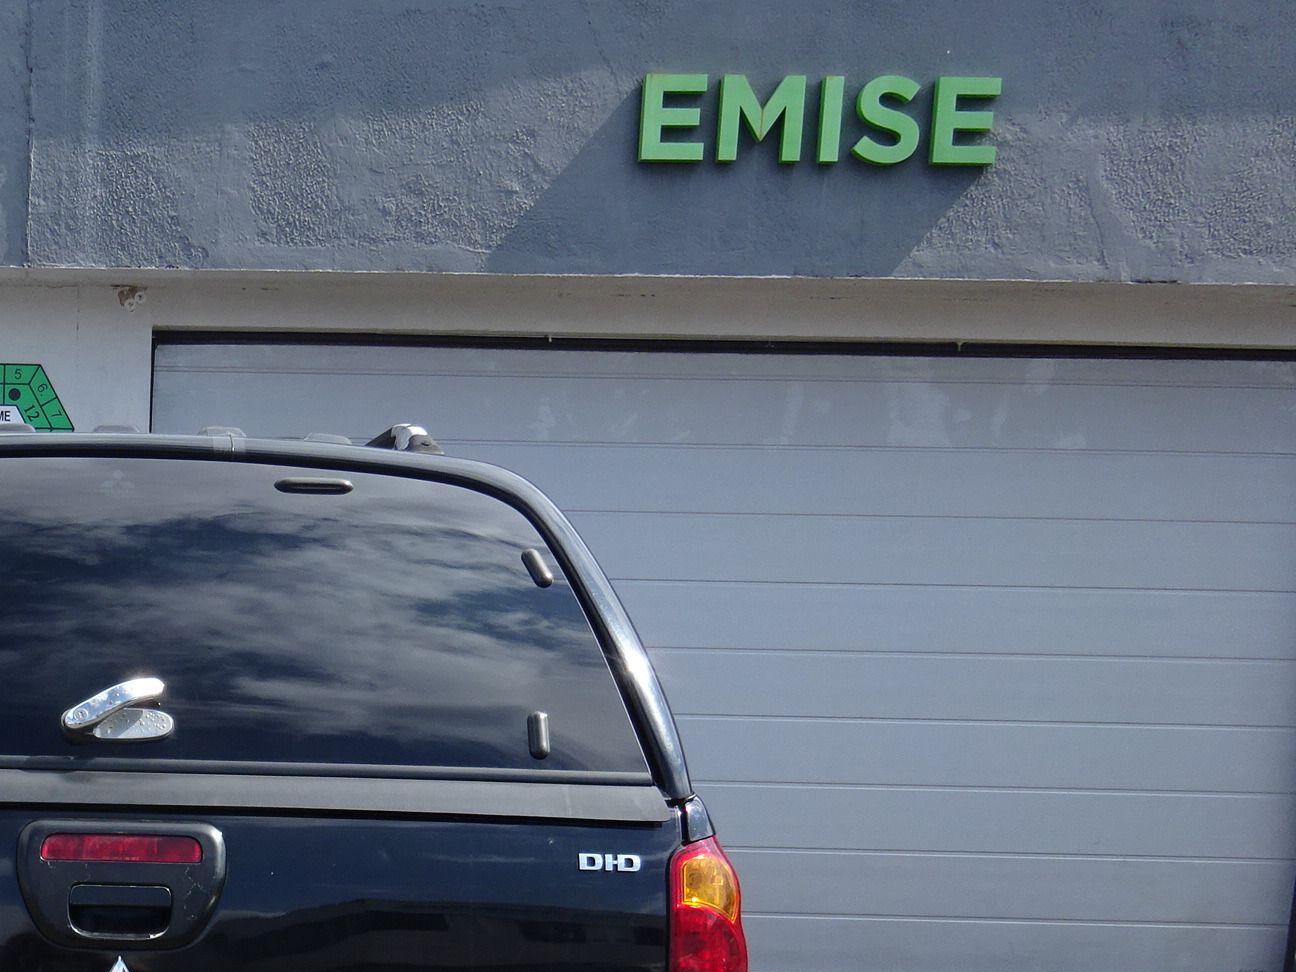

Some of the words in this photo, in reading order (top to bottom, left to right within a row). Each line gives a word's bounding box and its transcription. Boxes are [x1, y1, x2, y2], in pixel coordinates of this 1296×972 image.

[638, 73, 1003, 166] EMISE
[14, 368, 22, 380] 5
[24, 404, 40, 422] 12
[50, 410, 62, 419] 7
